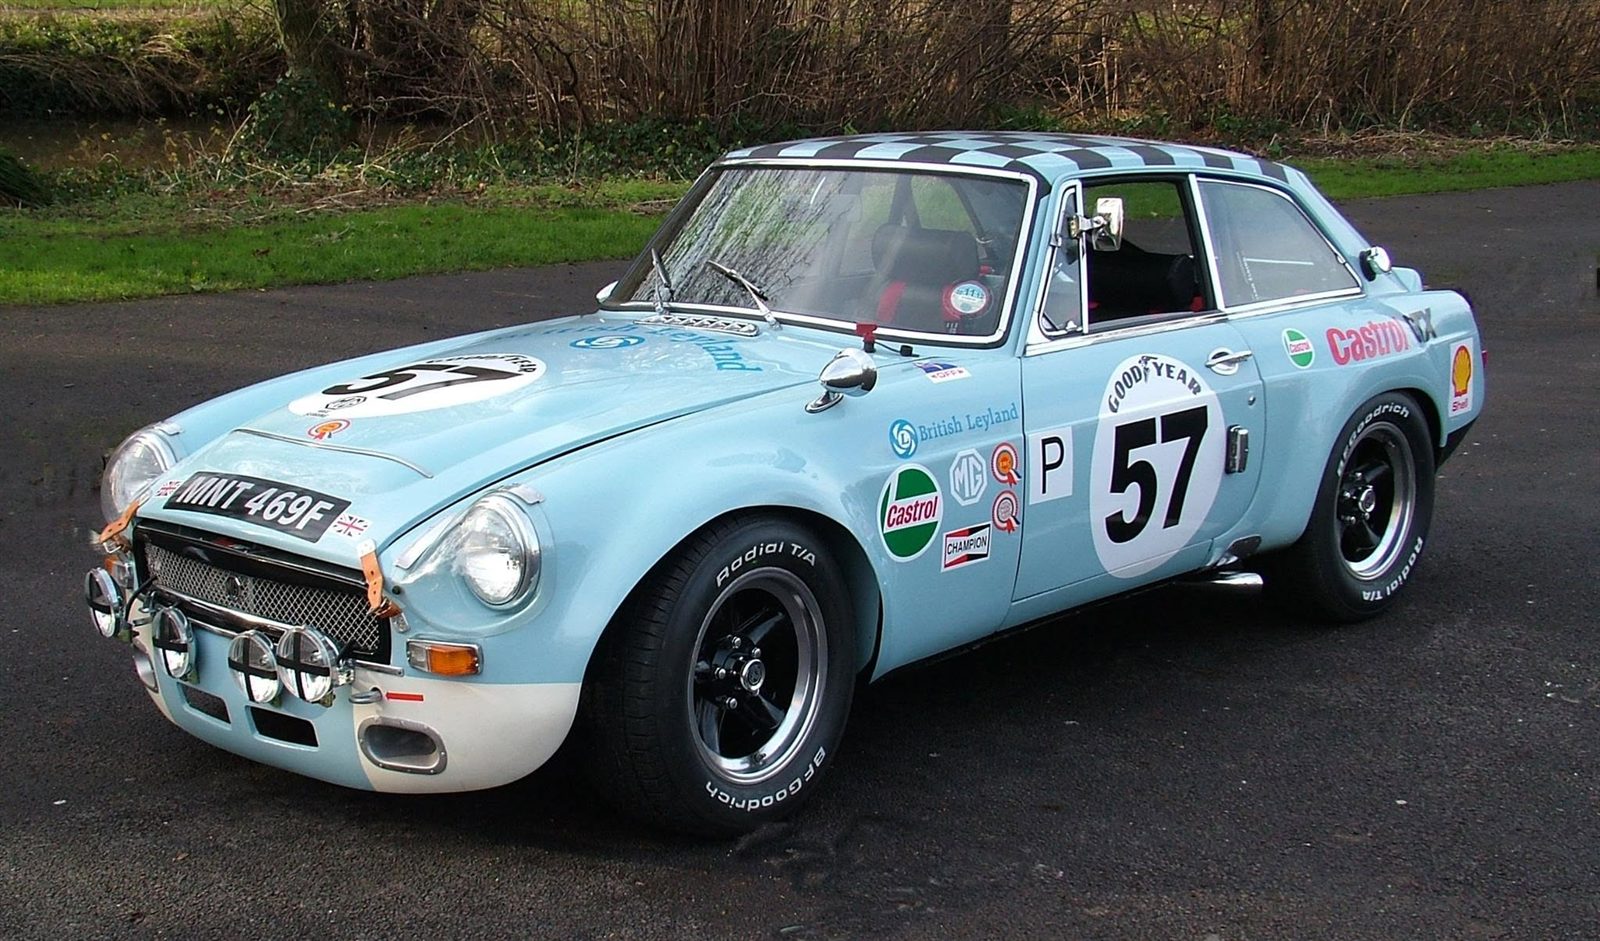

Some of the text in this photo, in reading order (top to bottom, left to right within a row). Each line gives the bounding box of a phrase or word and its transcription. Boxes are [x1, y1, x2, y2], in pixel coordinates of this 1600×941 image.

[1326, 316, 1409, 366] Castrol
[322, 364, 524, 400] 57
[918, 403, 1019, 441] British Leyland
[953, 455, 983, 498] MG
[1041, 436, 1064, 494] P
[1105, 405, 1208, 544] 57
[175, 476, 335, 531] MNT 469F
[886, 495, 939, 528] Castrol
[716, 541, 816, 587] Radial T/A
[947, 535, 987, 555] CHAMPION
[1386, 536, 1424, 596] Radial
